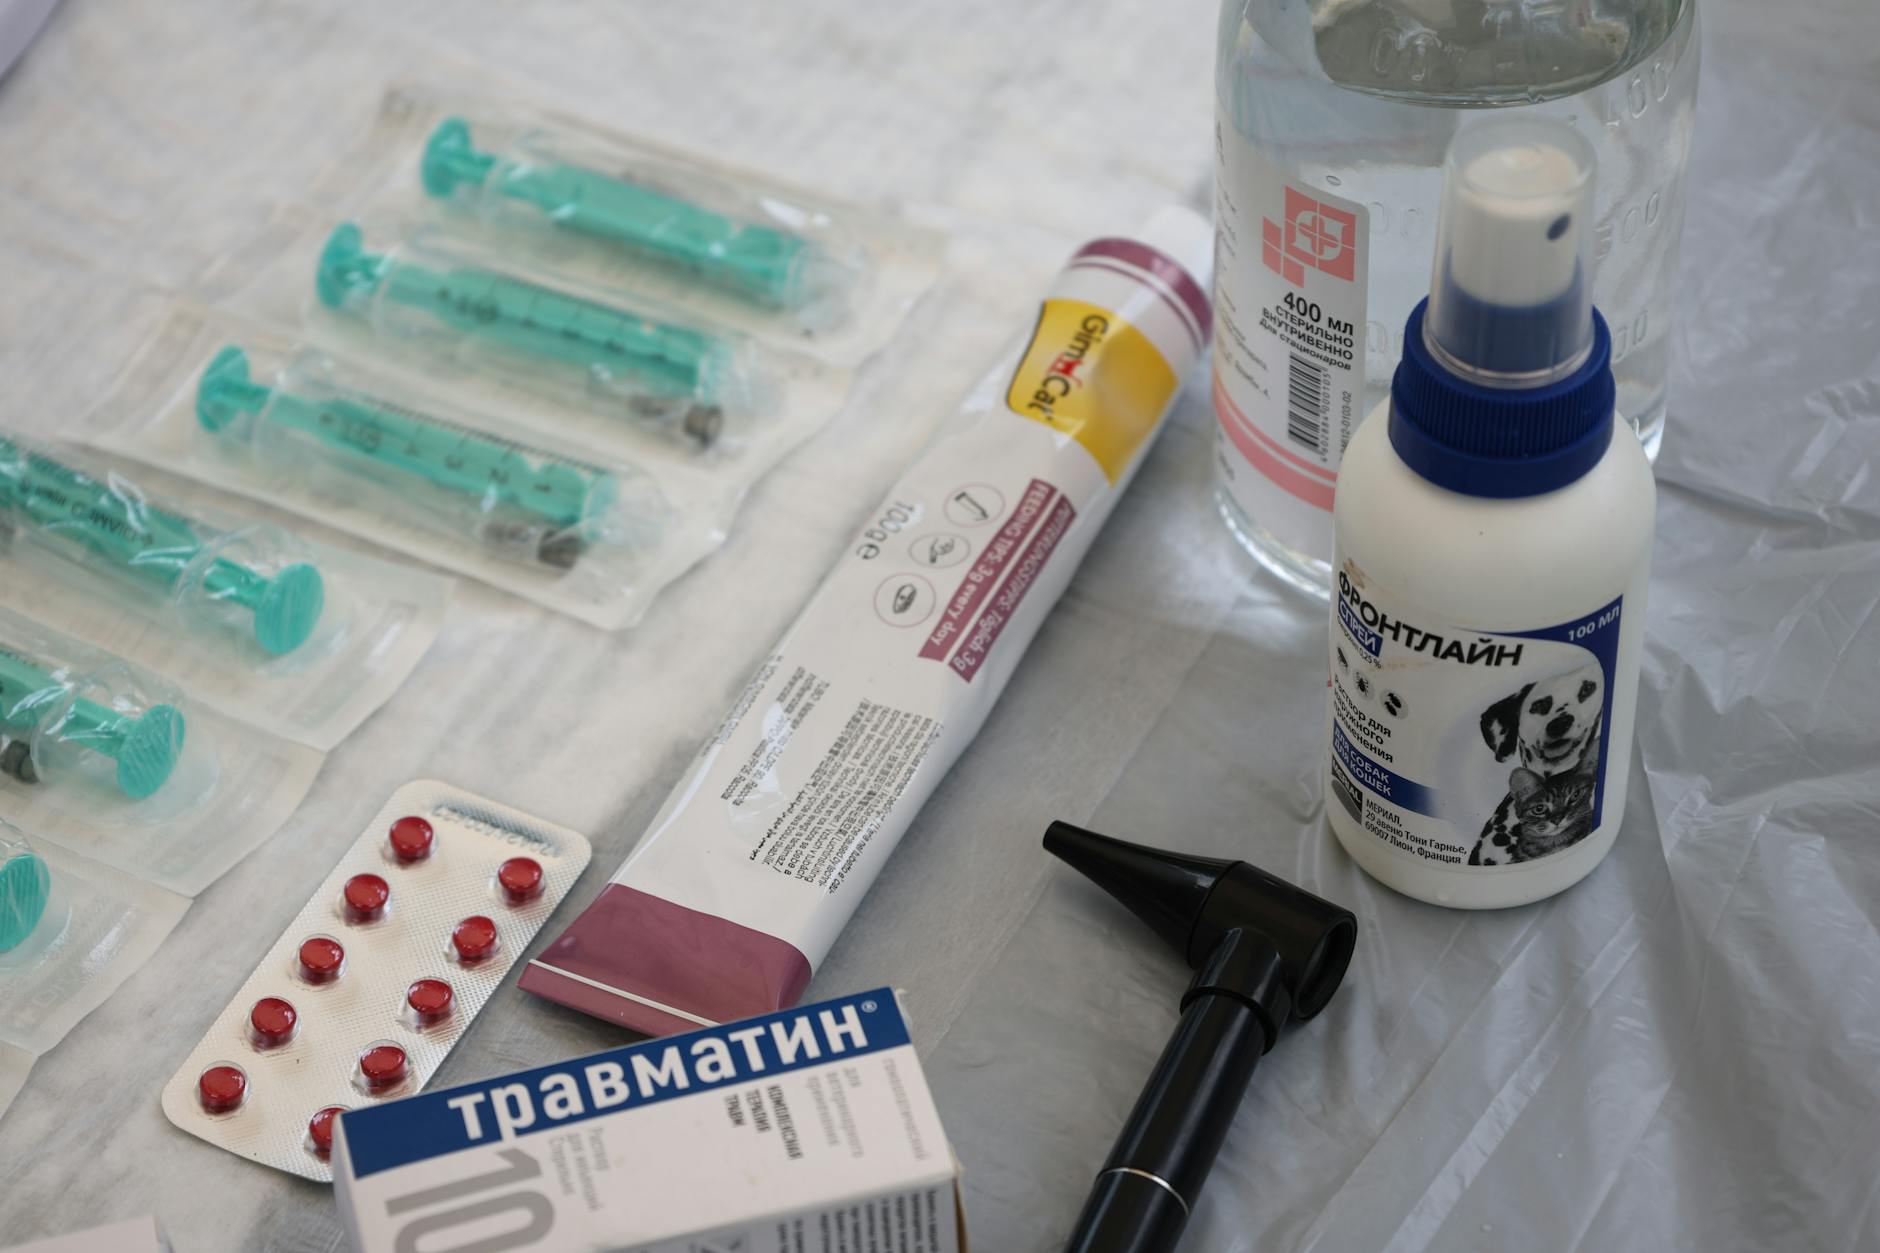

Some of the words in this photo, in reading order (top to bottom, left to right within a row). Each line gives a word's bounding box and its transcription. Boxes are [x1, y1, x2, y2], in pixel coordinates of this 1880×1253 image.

[1275, 305, 1354, 348] СТЕРИЛЬНО
[1283, 291, 1321, 323] 400
[1260, 318, 1278, 336] Для
[1280, 333, 1352, 371] стационаров
[1262, 307, 1354, 361] ВНУТРИВЕННО
[1008, 482, 1049, 539] FEEDING
[946, 582, 978, 620] every
[1339, 571, 1523, 667] ФРОНТЛАЙН
[930, 618, 957, 646] day
[1340, 600, 1377, 652] СПРЕЙ
[1568, 622, 1596, 641] 100
[1368, 718, 1392, 738] для
[1350, 749, 1389, 783] СОБАК
[1350, 761, 1391, 796] КОШЕК
[1365, 810, 1376, 821] 29
[1377, 818, 1403, 838] авеню
[1405, 830, 1427, 847] Тони
[1429, 838, 1468, 855] Гарнье,
[1366, 798, 1402, 827] МЕРИАЛ,
[1365, 821, 1389, 841] 69007
[1390, 834, 1415, 855] Лион,
[1417, 846, 1462, 864] Франция
[724, 1094, 746, 1128] ТРАВМ
[746, 1089, 771, 1134] ТЕРАПИЯ
[766, 1083, 803, 1160] КОМПЛЕКСНАЯ
